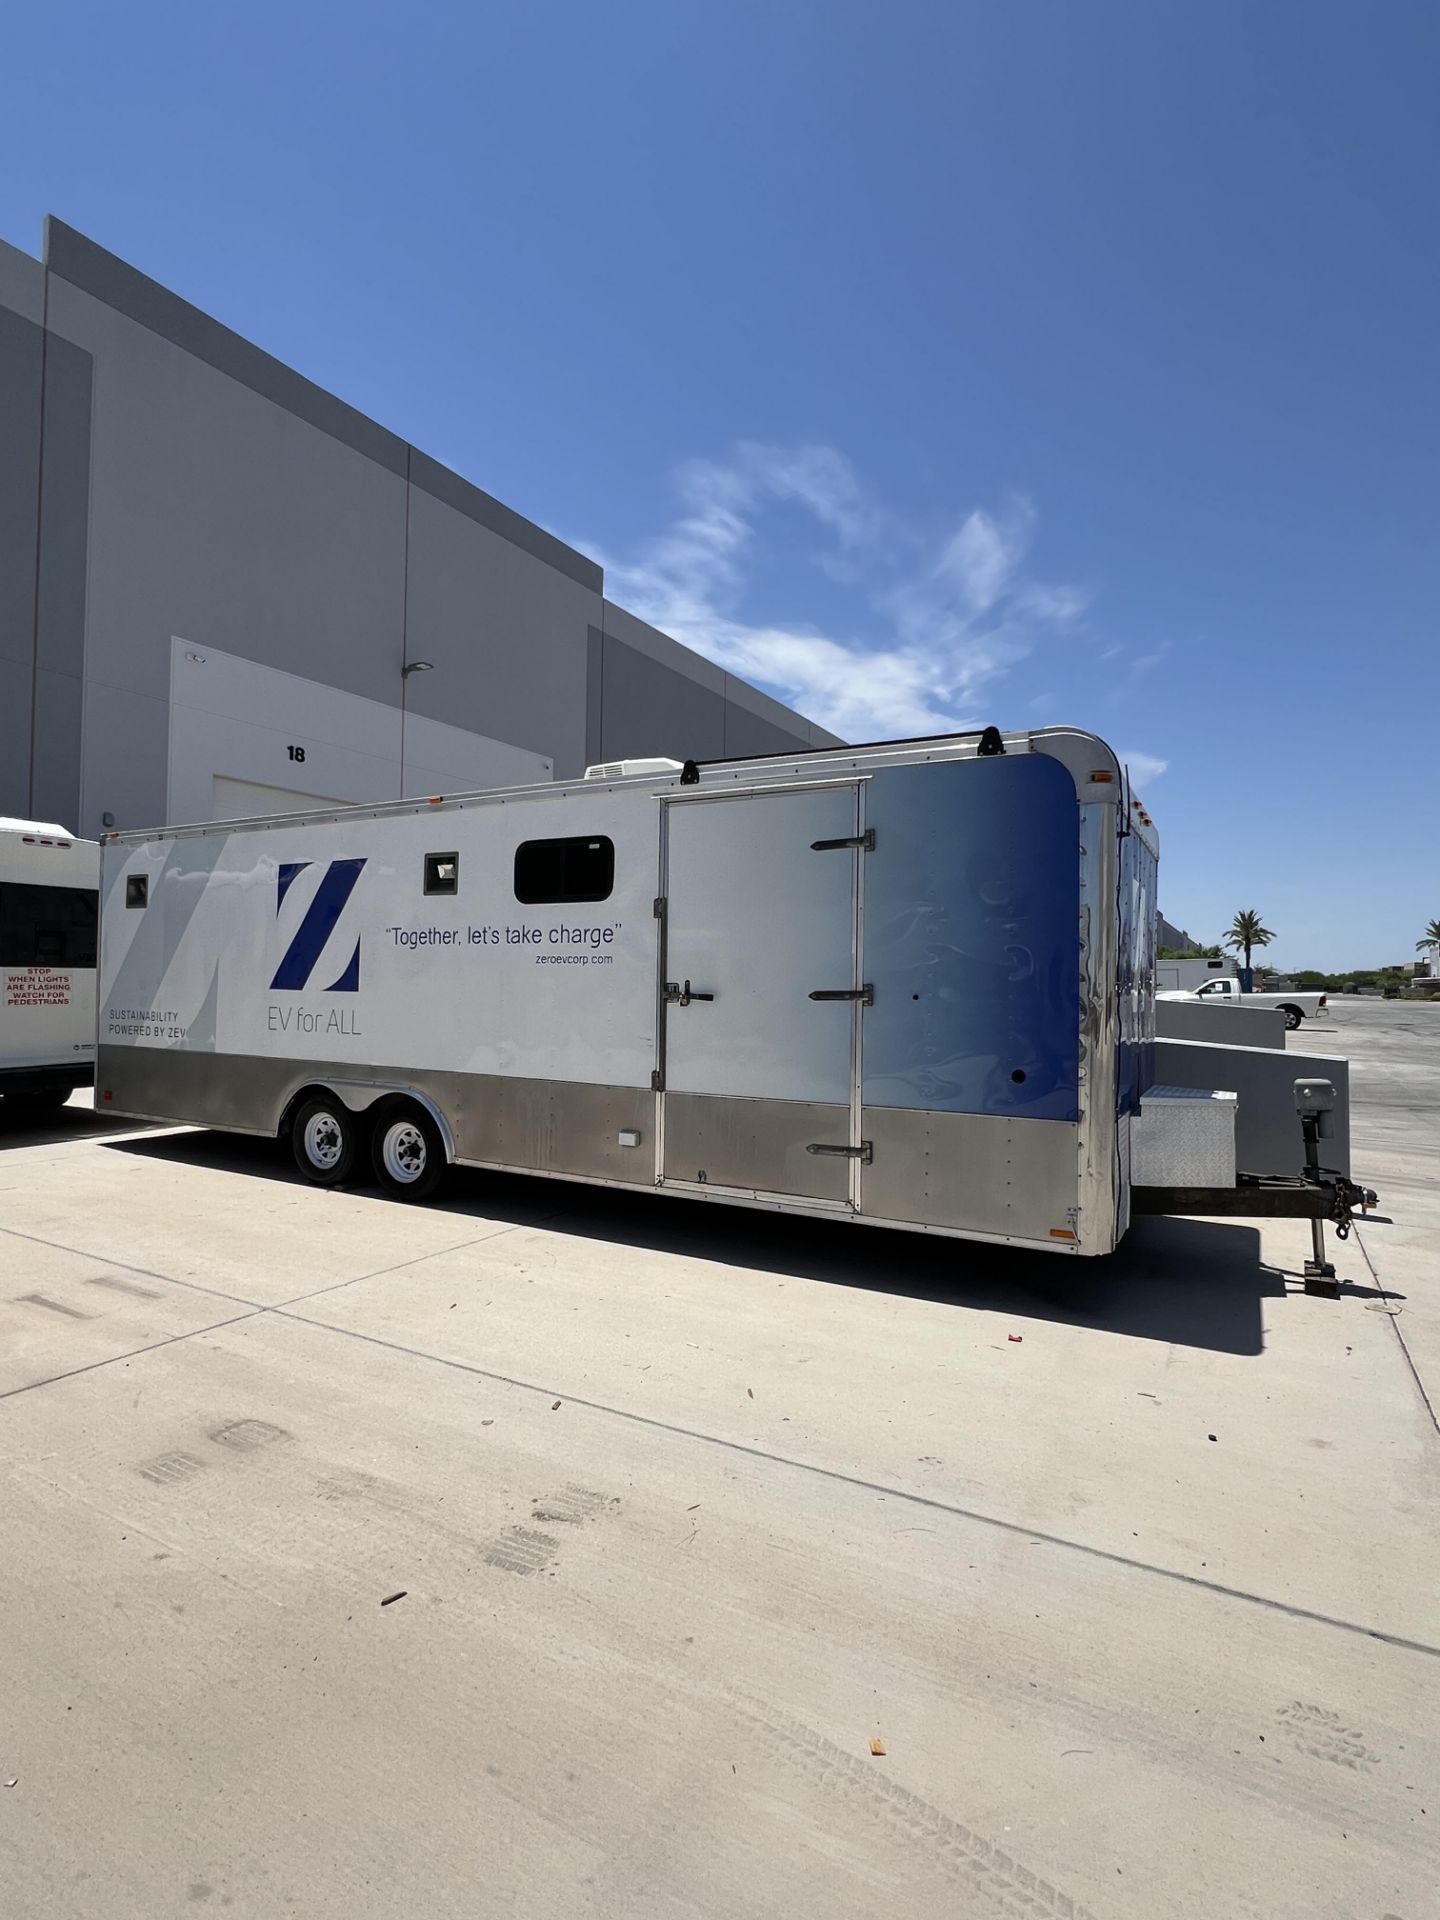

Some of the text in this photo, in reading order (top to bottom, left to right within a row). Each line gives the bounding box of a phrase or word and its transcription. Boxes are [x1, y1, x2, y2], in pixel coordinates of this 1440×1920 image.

[287, 745, 305, 762] 18
[386, 923, 622, 949] “Together, let’s take charge”
[536, 954, 613, 966] zeroevcorp.com
[109, 1009, 178, 1021] SUSTAINABILITY
[268, 1006, 362, 1035] EV for ALL
[109, 1024, 186, 1038] POWERED BY ZEV
